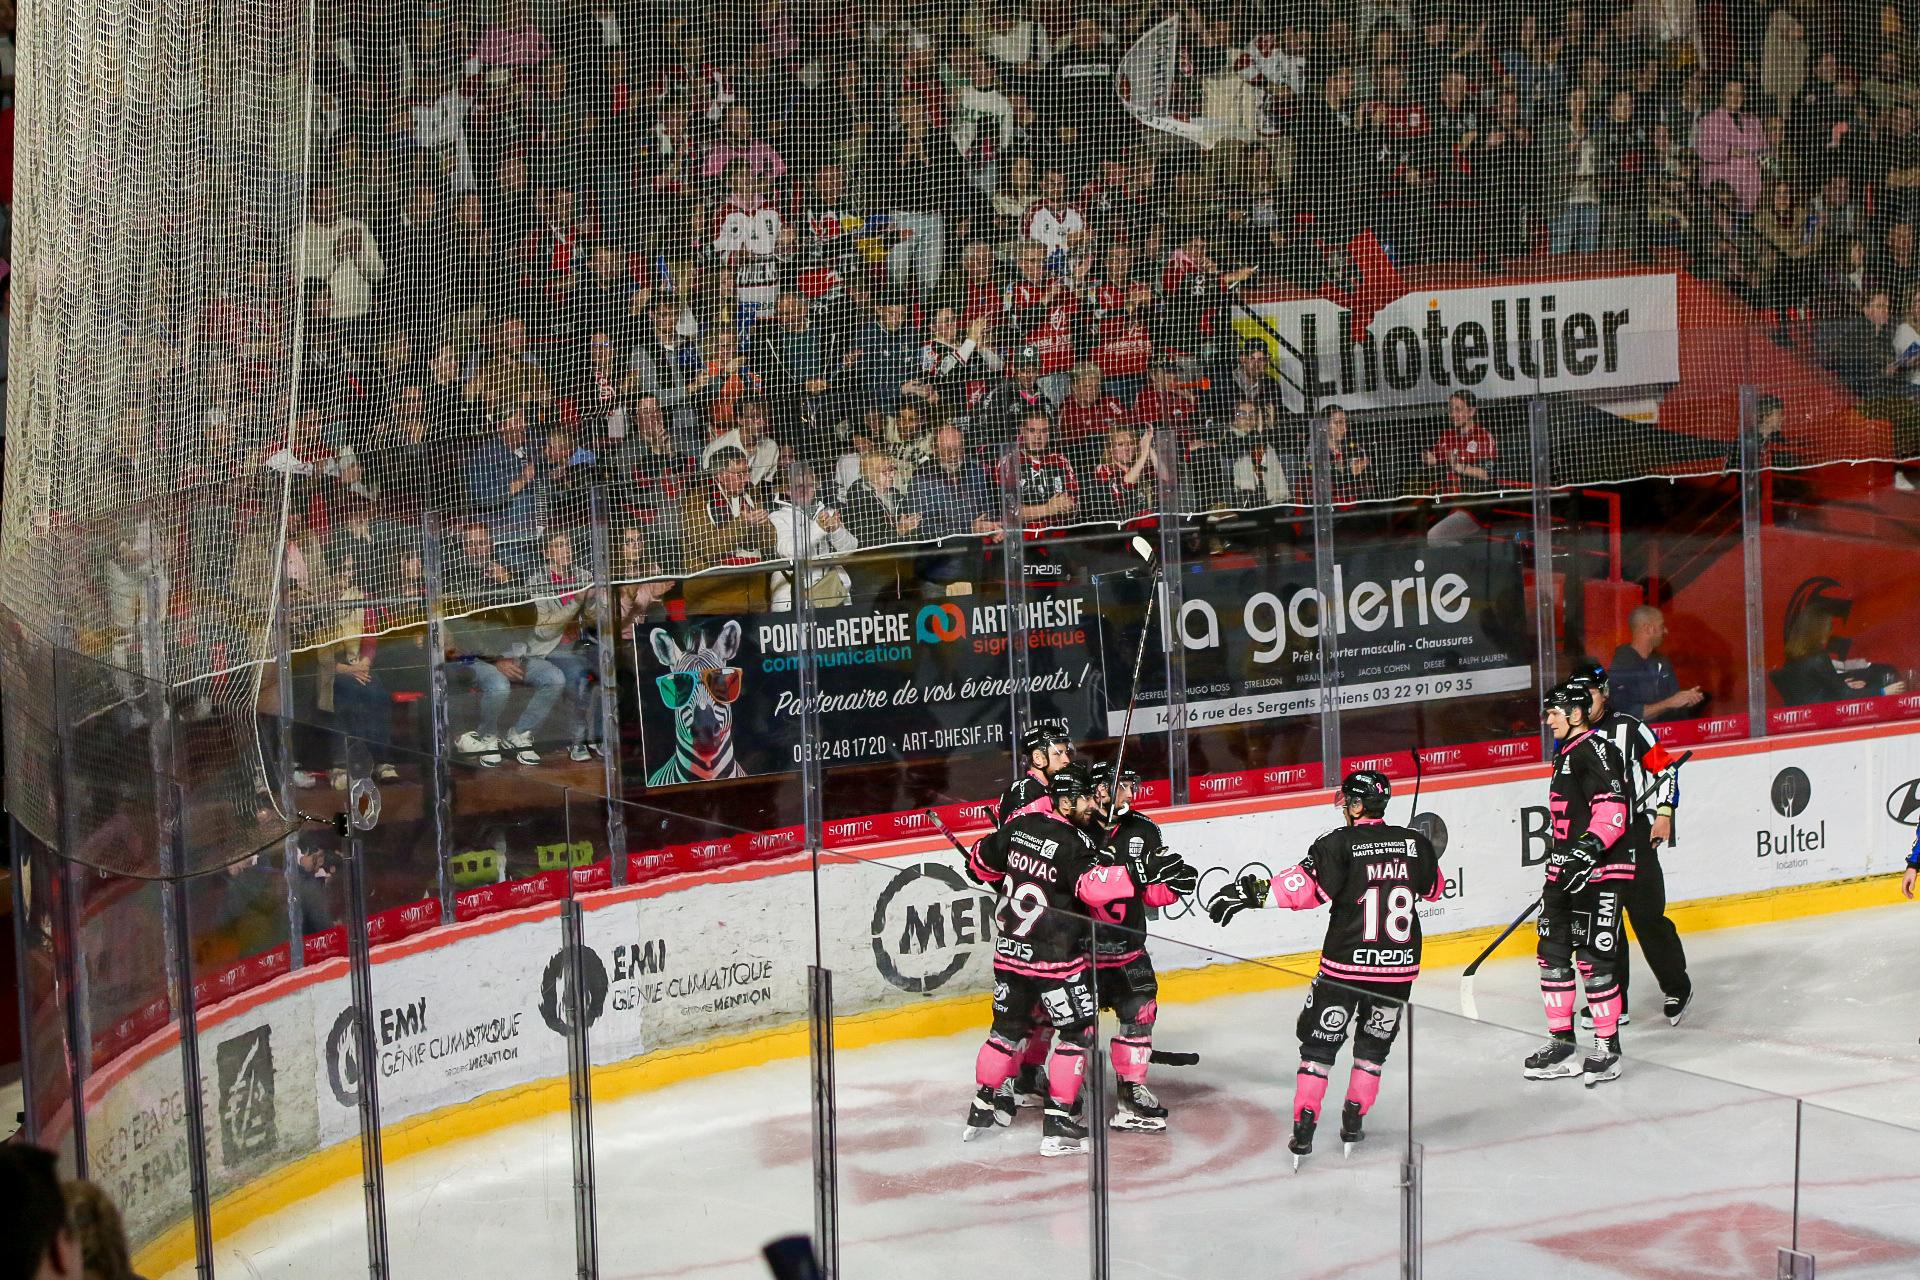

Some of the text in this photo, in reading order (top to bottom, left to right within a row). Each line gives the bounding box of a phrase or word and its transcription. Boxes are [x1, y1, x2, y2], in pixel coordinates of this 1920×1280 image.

[1158, 559, 1471, 664] la galerie
[1292, 650, 1314, 663] Prêt
[1361, 640, 1406, 657] masculin
[1415, 635, 1474, 651] Chaussures
[1210, 683, 1231, 693] BOSS
[1243, 677, 1283, 690] STRELLSON
[1383, 663, 1411, 675] COHEN
[892, 679, 918, 706] de
[923, 682, 956, 703] vos
[1202, 708, 1224, 720] rue
[1229, 703, 1253, 717] des
[1257, 697, 1316, 715] Sergents
[1373, 687, 1390, 702] 03
[1394, 685, 1411, 699] 22
[1415, 683, 1430, 696] 91
[1434, 681, 1453, 695] 09
[1456, 678, 1473, 692] 35
[1773, 708, 1812, 724] somme
[1836, 700, 1875, 716] somme
[1698, 717, 1737, 733] somme
[1419, 748, 1462, 765] somme
[1488, 740, 1529, 757] somme
[1350, 757, 1393, 772] somme
[1200, 774, 1243, 791] somme
[1264, 767, 1306, 784] somme
[829, 819, 873, 837] somme
[1756, 820, 1825, 858] Bultel
[1365, 857, 1409, 882] MAÏA
[1776, 857, 1809, 871] location
[1358, 886, 1415, 943] 18
[1597, 892, 1615, 927] EMI
[612, 938, 666, 983] EMI
